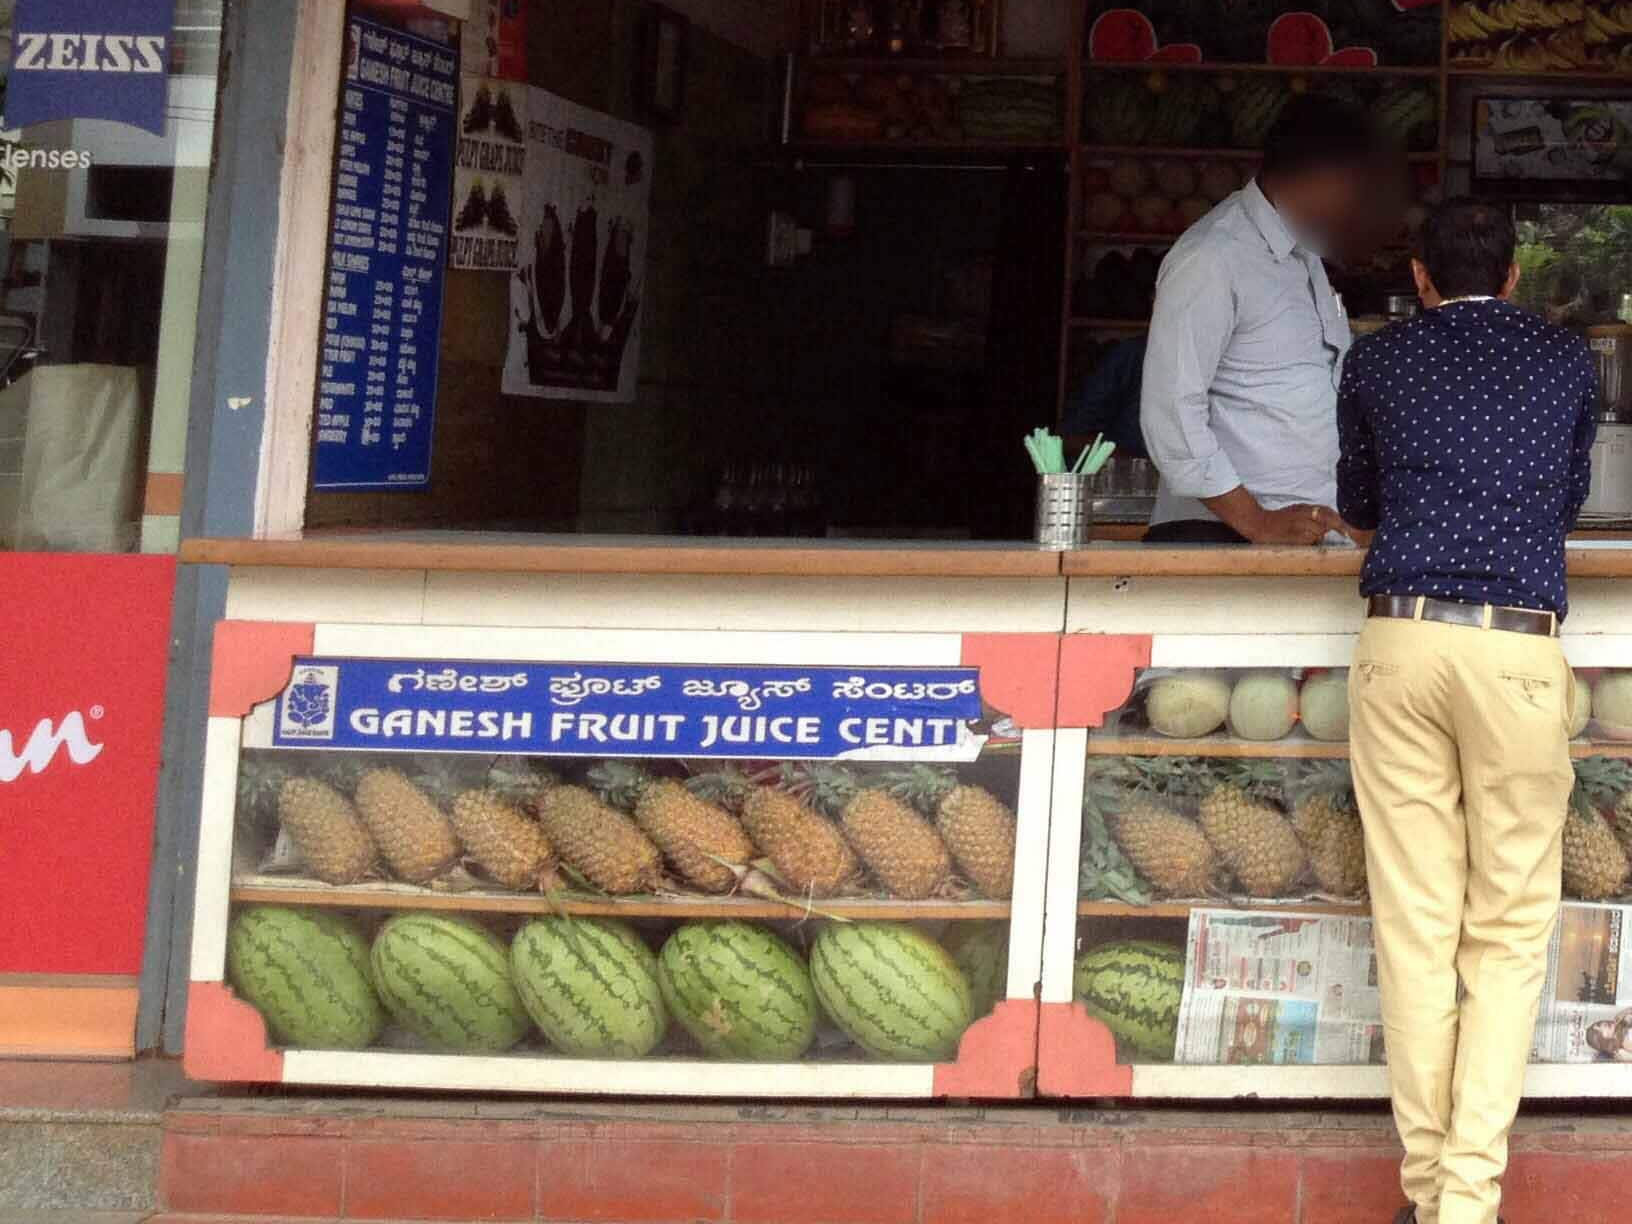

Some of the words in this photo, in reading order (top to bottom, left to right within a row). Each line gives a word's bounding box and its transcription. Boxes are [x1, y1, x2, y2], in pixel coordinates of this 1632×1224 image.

[15, 34, 166, 73] ZEISS
[388, 668, 528, 694] ಗಣೇಶ್
[350, 707, 532, 742] GANESH
[550, 712, 686, 744] FRUIT
[700, 714, 820, 748] JUICE
